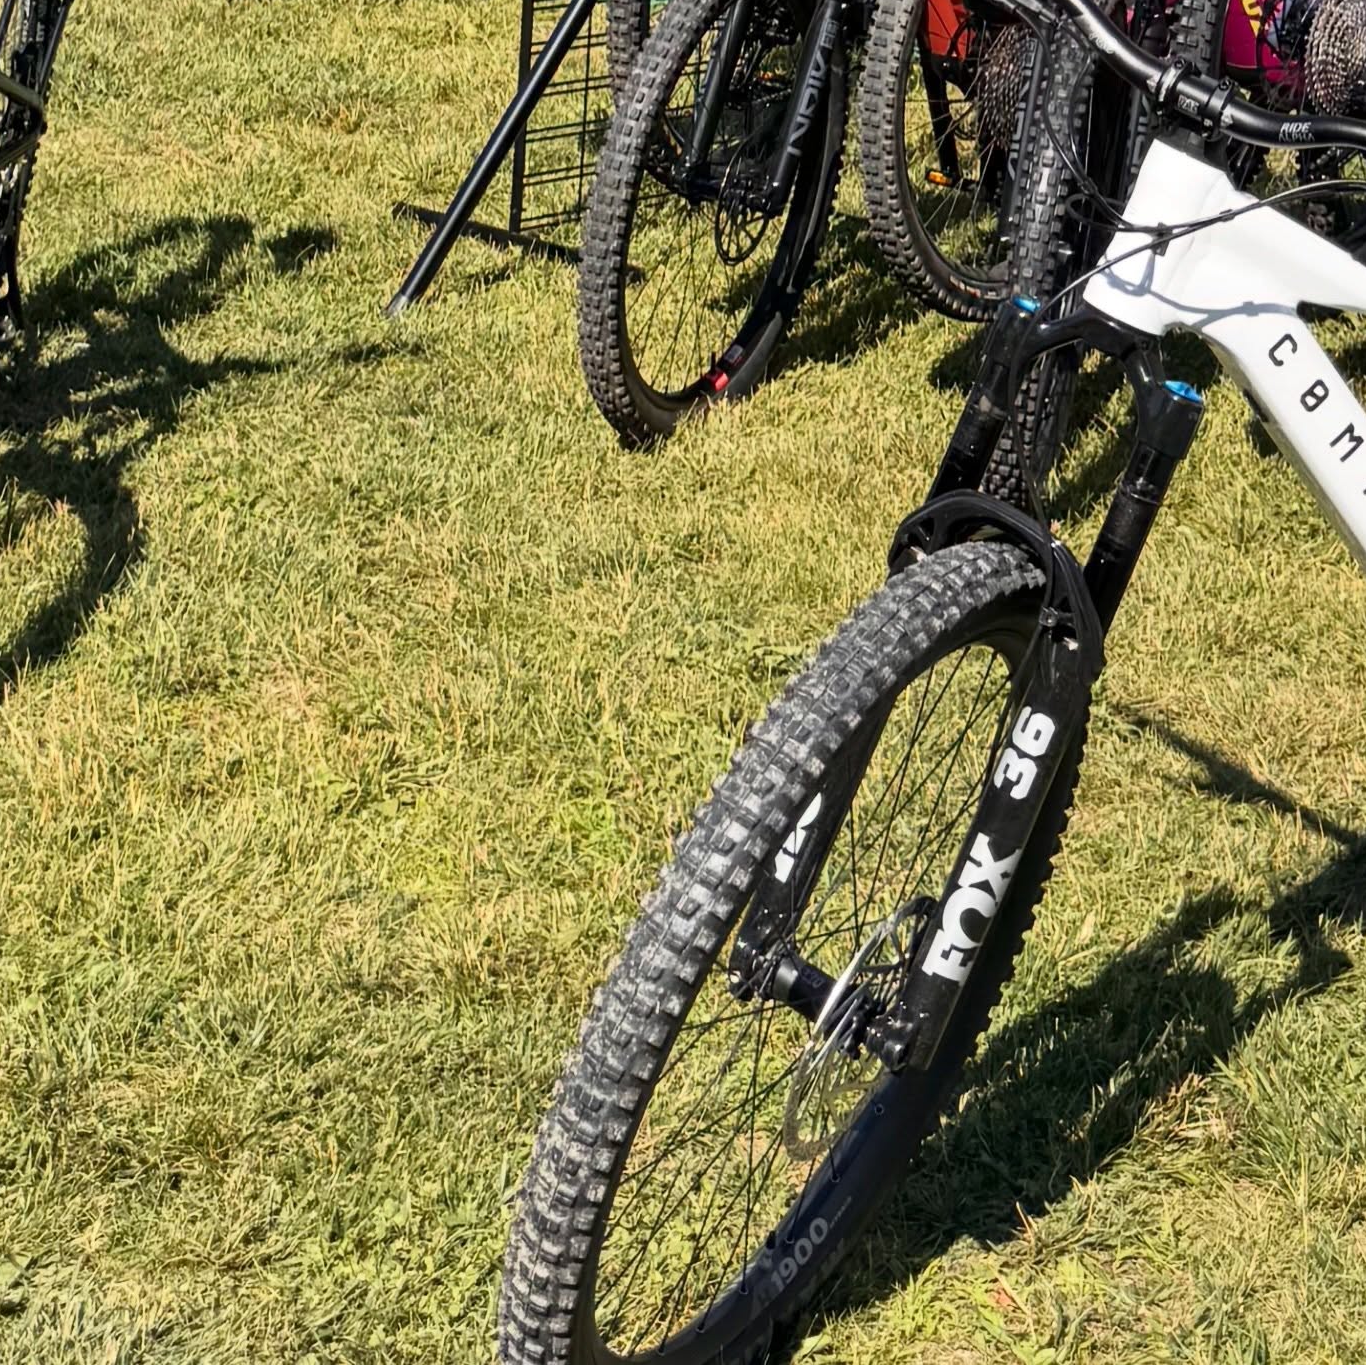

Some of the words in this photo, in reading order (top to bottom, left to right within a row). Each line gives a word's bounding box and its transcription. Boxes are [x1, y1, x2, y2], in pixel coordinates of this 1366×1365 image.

[1280, 121, 1312, 133] RIDE
[921, 831, 1023, 987] FOX
[992, 705, 1058, 801] 36
[770, 1215, 829, 1294] 1900
